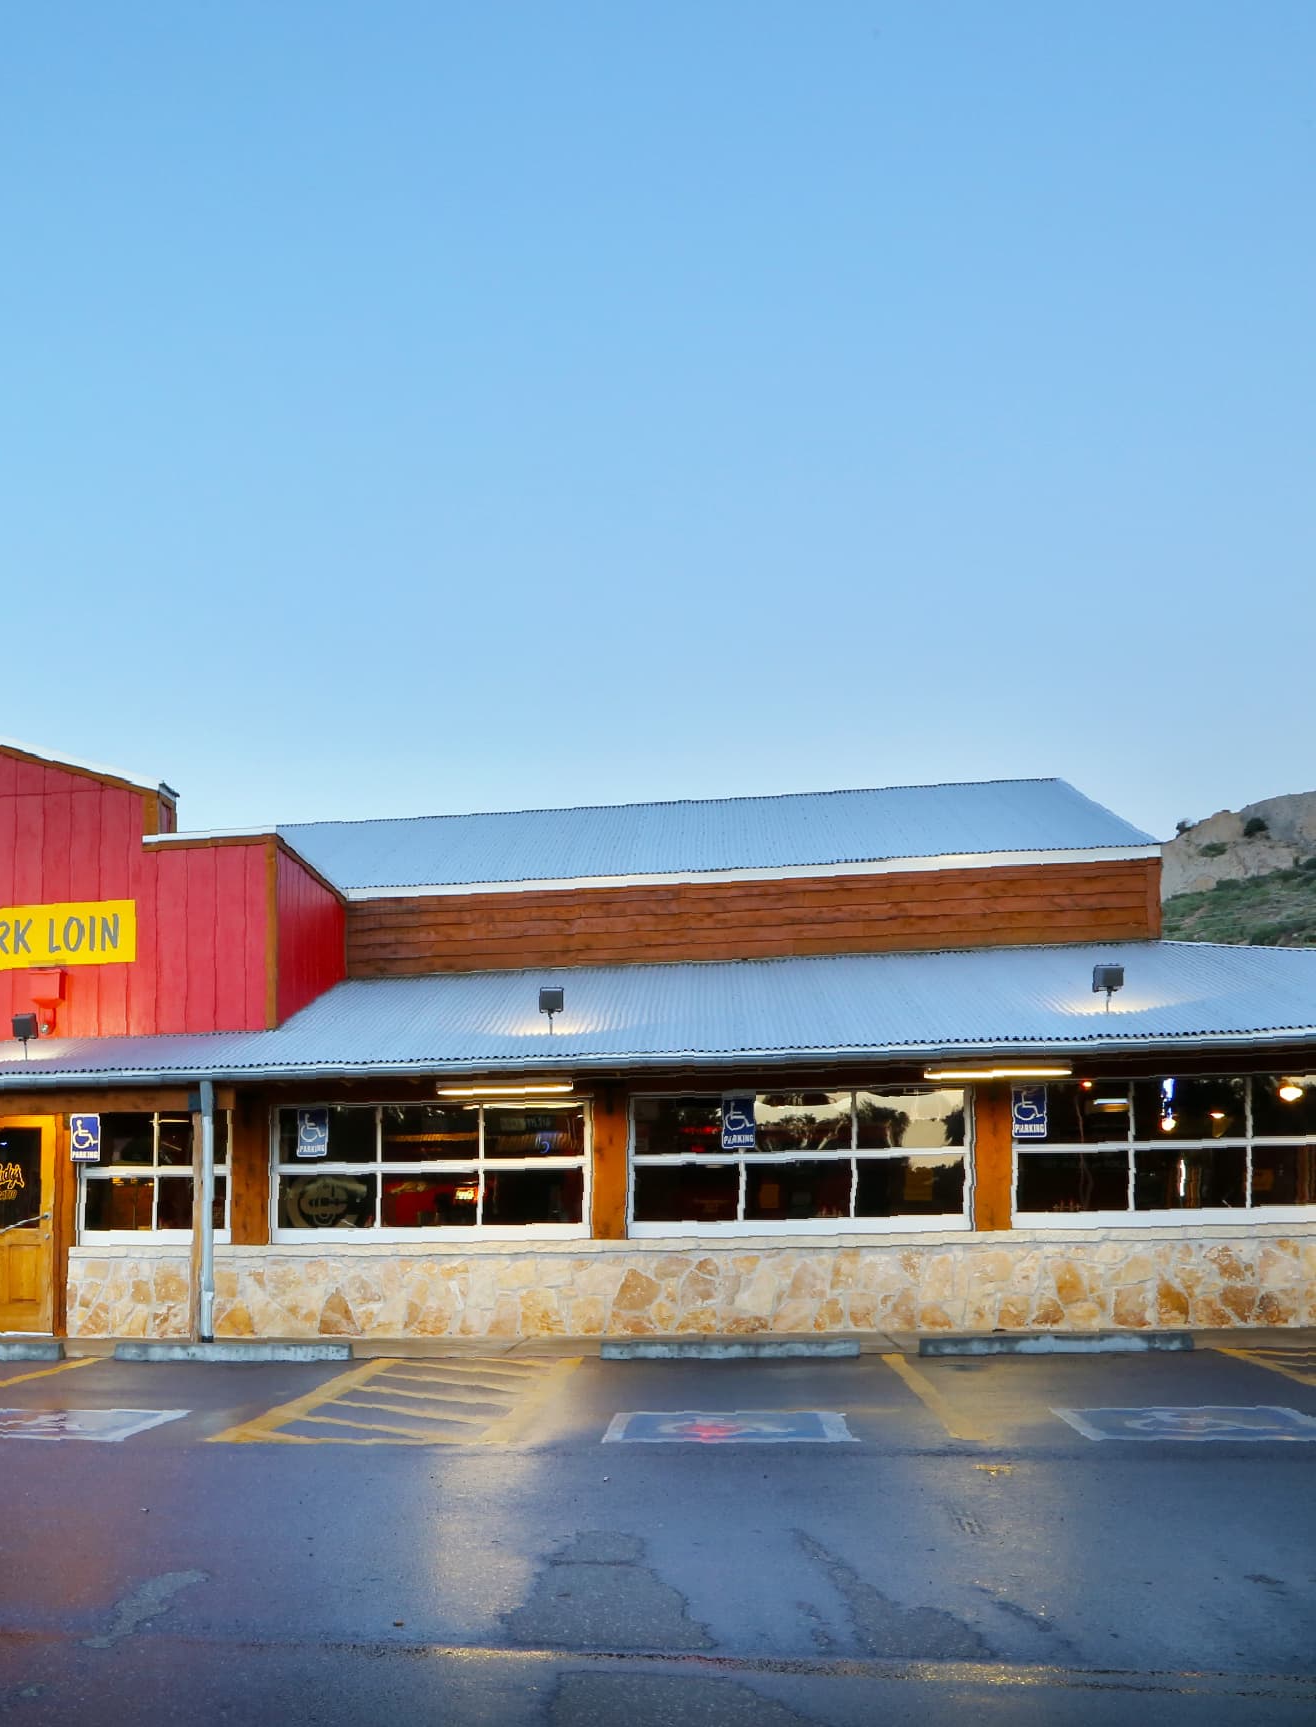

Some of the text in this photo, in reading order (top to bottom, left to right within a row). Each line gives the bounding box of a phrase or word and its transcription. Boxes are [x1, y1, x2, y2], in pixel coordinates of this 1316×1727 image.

[48, 913, 120, 954] LOIN
[1014, 1124, 1044, 1133] PARKING
[724, 1134, 754, 1144] PARKING
[72, 1151, 99, 1159] PARKING
